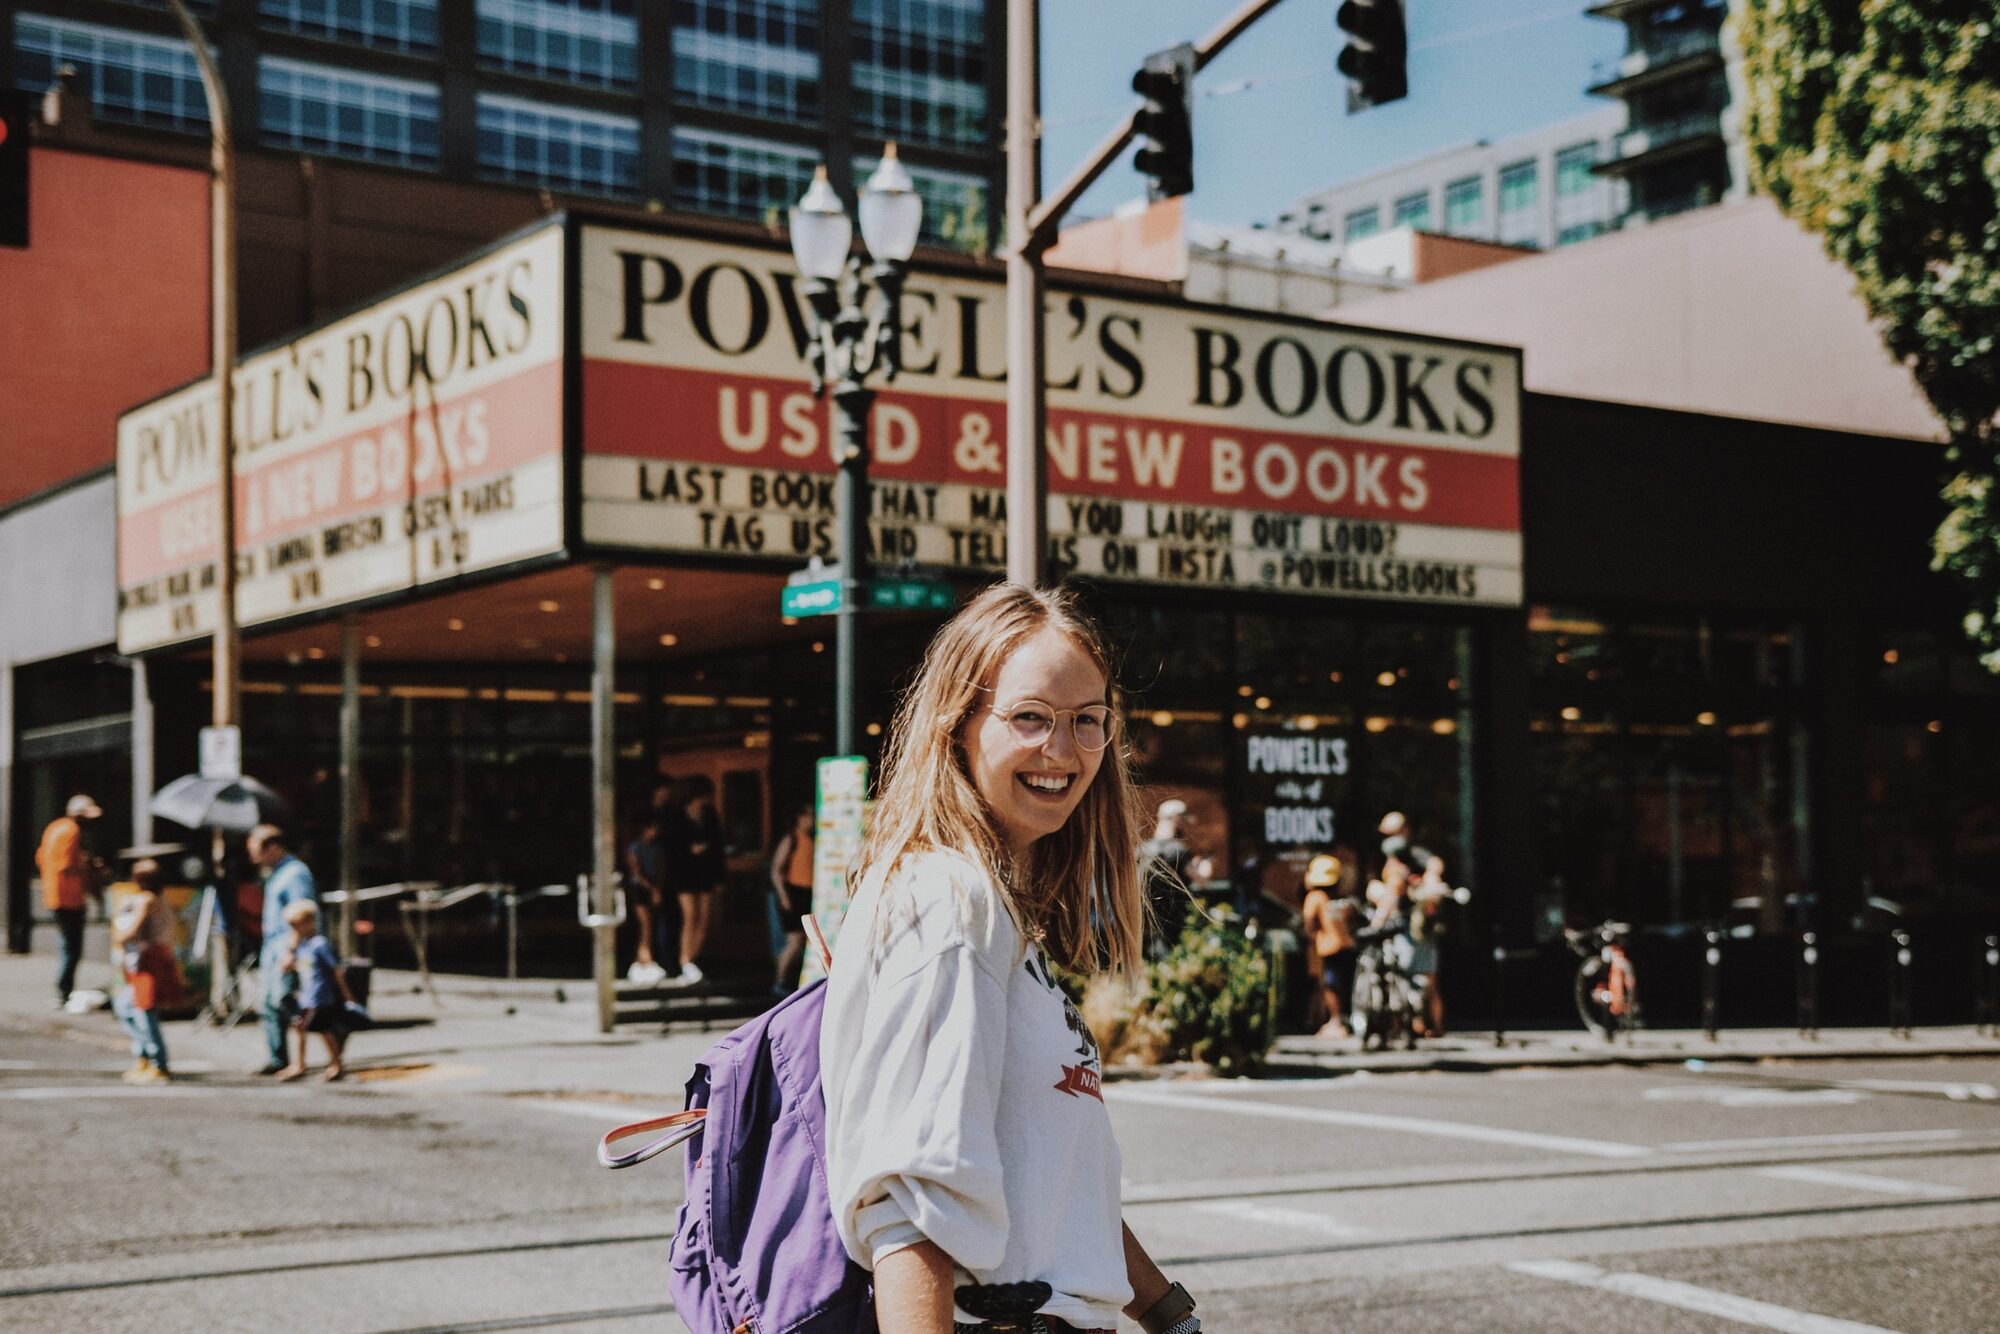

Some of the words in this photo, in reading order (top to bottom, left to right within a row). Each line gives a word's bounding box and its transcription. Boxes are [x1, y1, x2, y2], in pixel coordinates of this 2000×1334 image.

[134, 342, 323, 494] POWLL'S
[347, 259, 532, 413] BOOKS
[1191, 326, 1496, 439] BOOKS
[352, 401, 488, 500] BOOKS
[719, 387, 920, 465] USD
[954, 411, 1002, 474] &
[1044, 420, 1184, 489] NEW
[1210, 437, 1429, 511] BOOKS
[638, 463, 724, 507] LAST
[750, 471, 836, 516] BOOK
[1067, 501, 1123, 537] YOU
[1147, 504, 1233, 542] LAUGH
[1252, 514, 1301, 550] OUT
[1321, 520, 1397, 557] LOUD?
[699, 511, 765, 552] TAG
[791, 518, 832, 557] US
[948, 529, 1007, 566] TEL
[1102, 540, 1139, 575] ON
[1157, 545, 1236, 583] INSTA
[1261, 553, 1477, 599] @POWELLSBOOKS
[1247, 735, 1348, 775] POWELL'S
[1265, 806, 1334, 843] BOOKS
